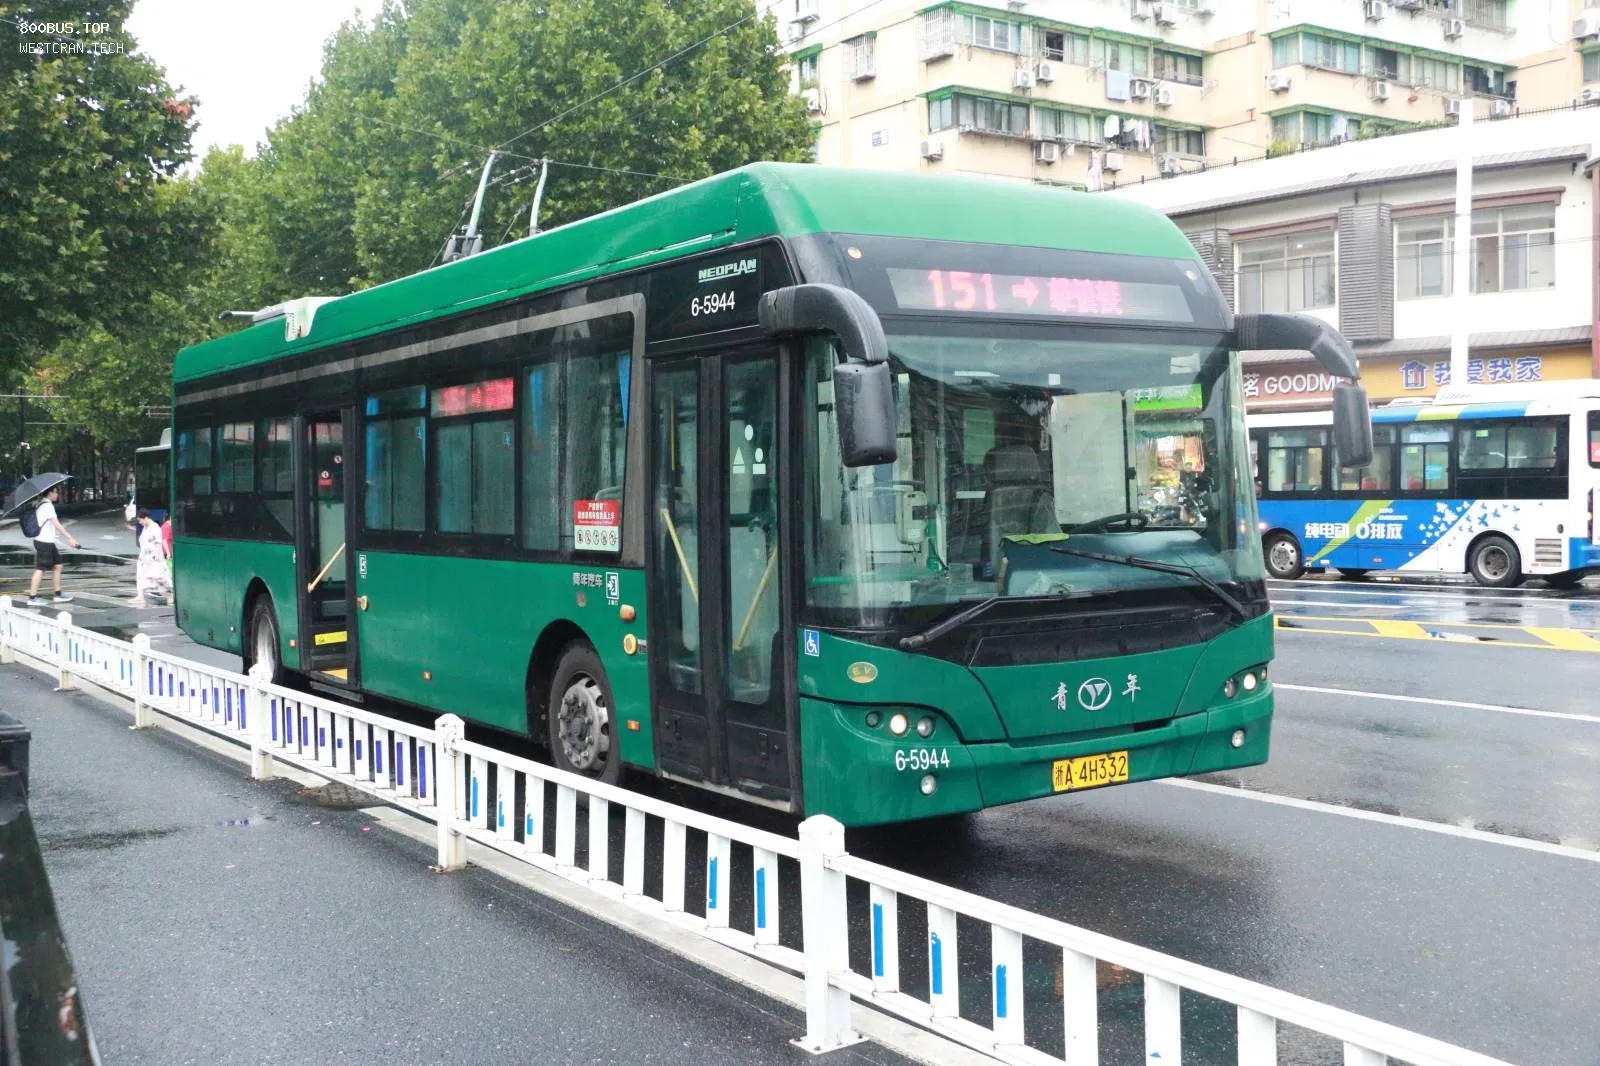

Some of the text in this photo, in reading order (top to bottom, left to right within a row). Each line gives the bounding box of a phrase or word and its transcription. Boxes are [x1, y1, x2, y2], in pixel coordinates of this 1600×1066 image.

[698, 259, 757, 281] NEOPLAN
[928, 270, 997, 311] 151
[691, 291, 735, 316] 6-5944
[1051, 674, 1141, 711] 青 年
[895, 748, 950, 771] 6-5944
